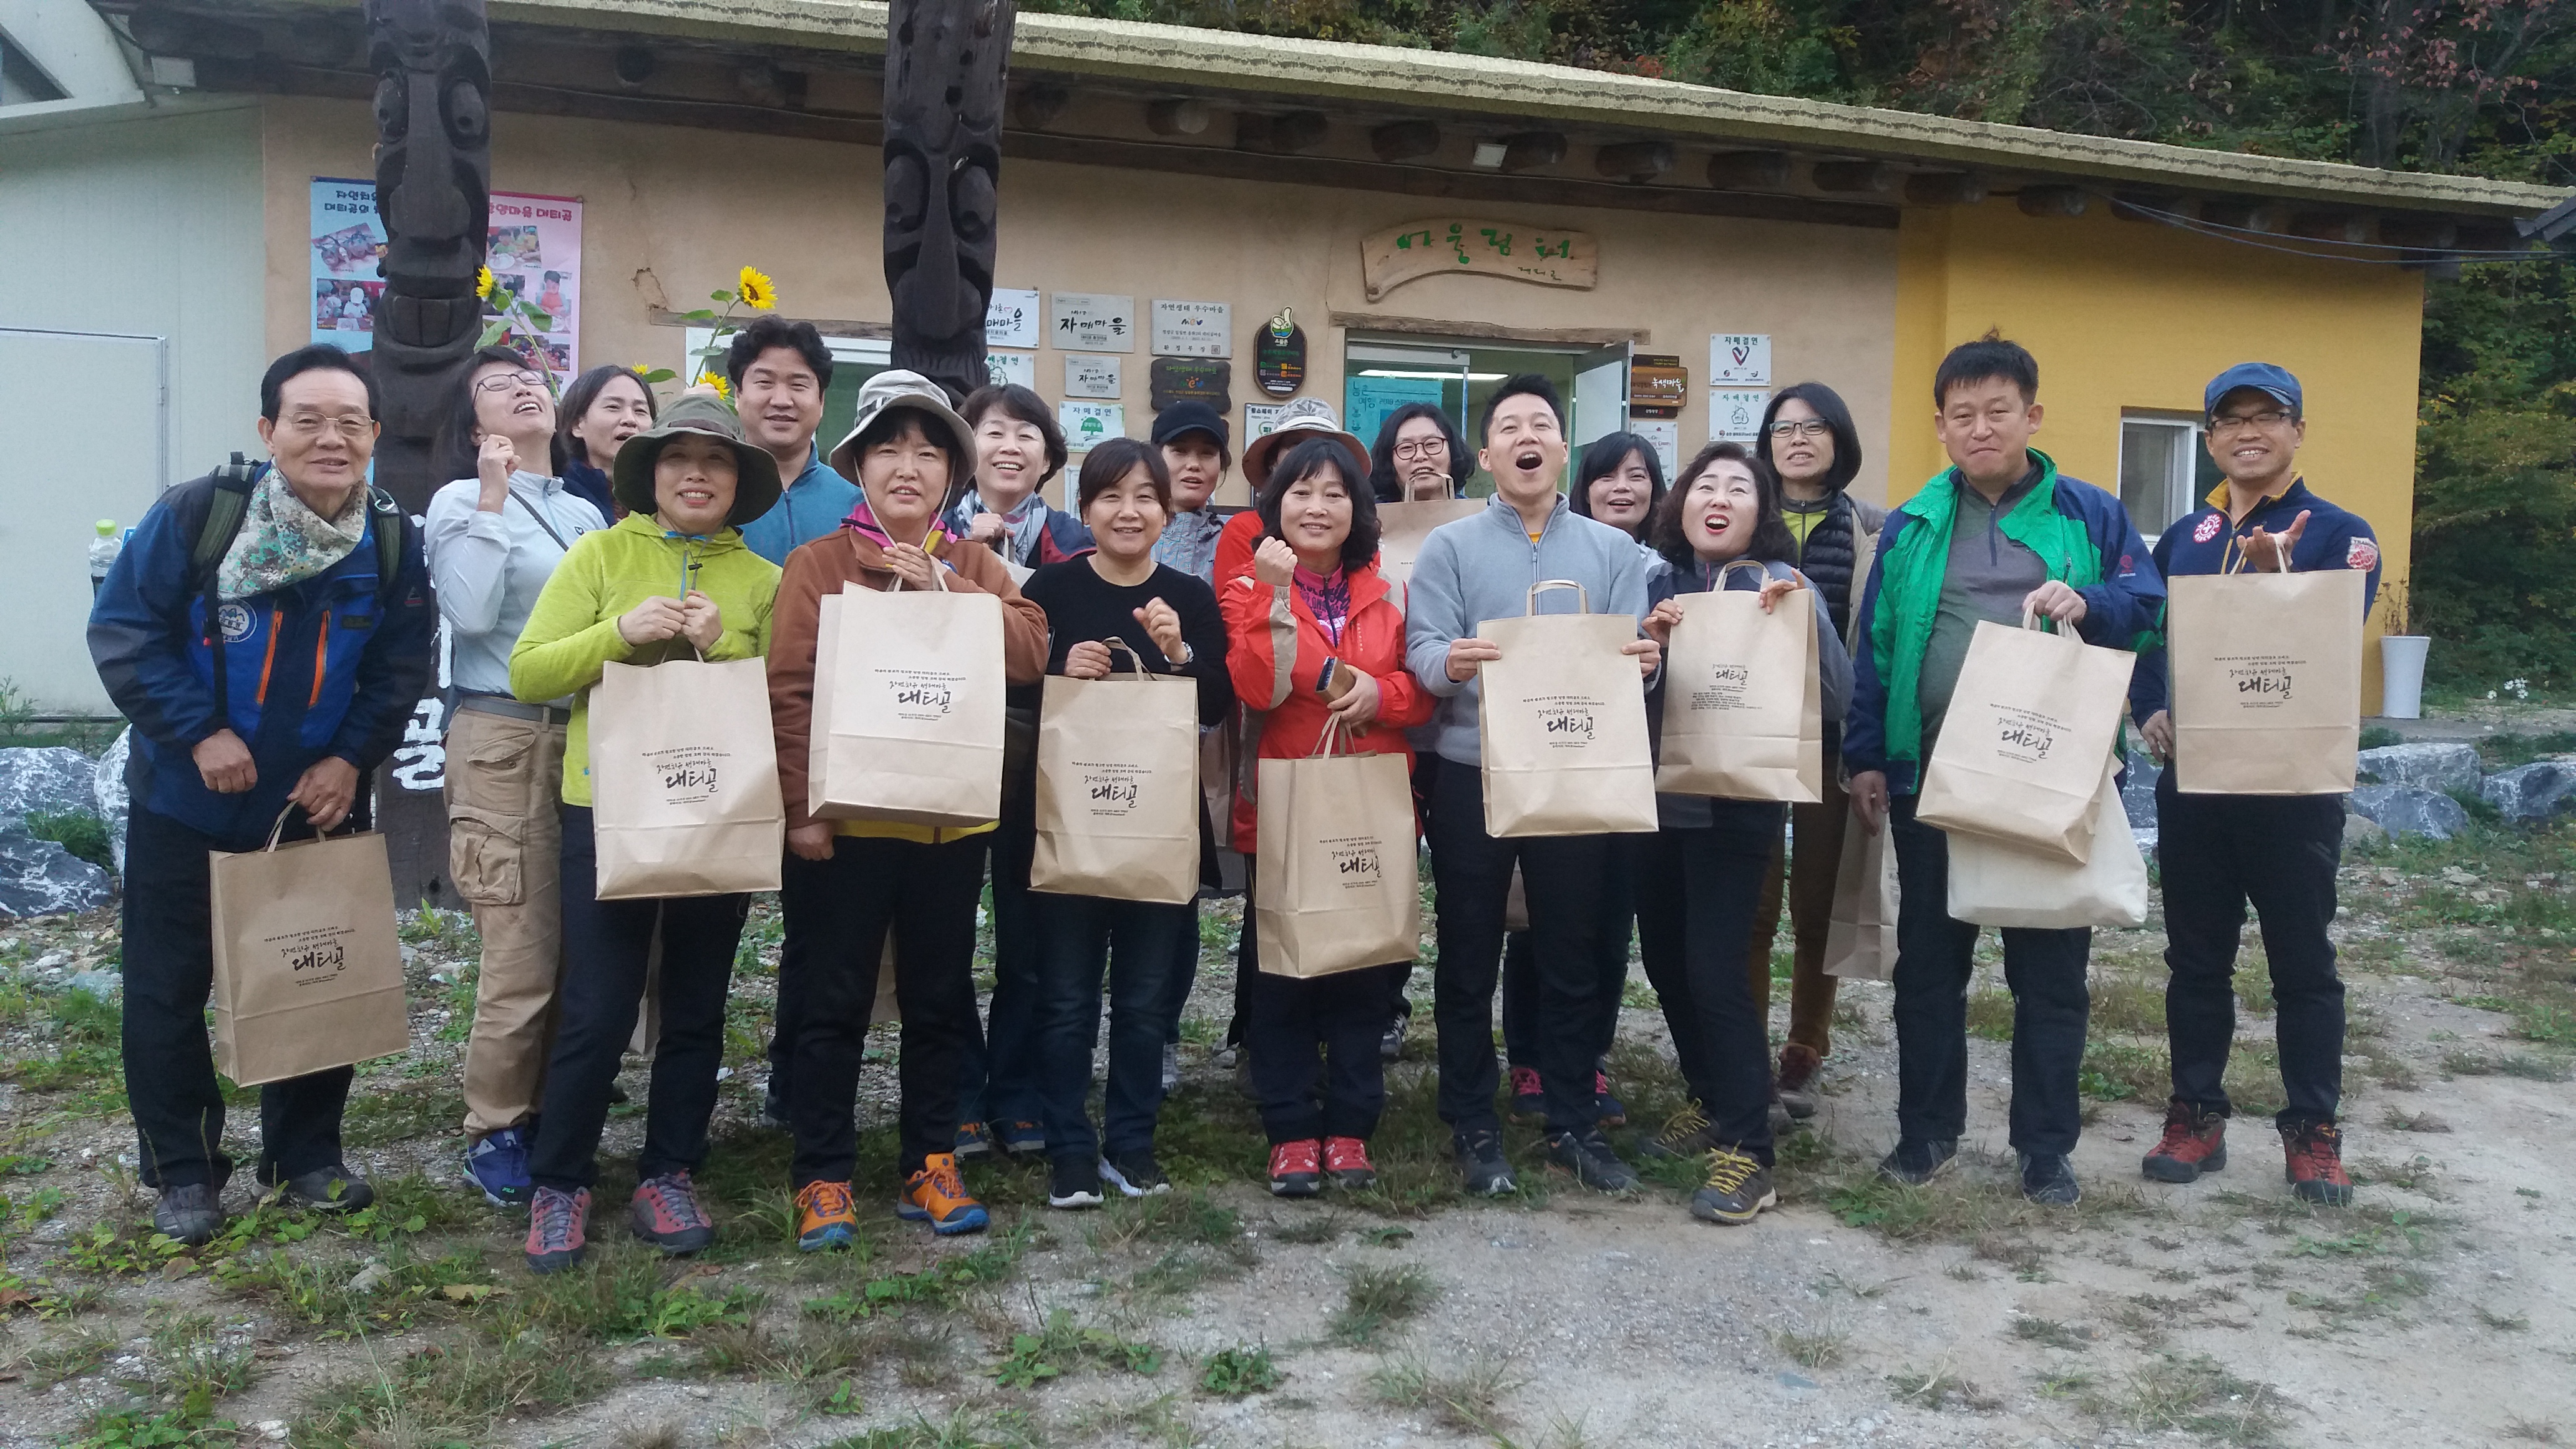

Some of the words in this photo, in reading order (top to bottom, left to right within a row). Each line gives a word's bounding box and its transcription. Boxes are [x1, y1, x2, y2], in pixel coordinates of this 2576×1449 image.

[986, 307, 1023, 332] 매마을
[1161, 303, 1191, 311] 자연생태
[1194, 305, 1224, 314] 우수마을
[1060, 316, 1127, 336] 자매마을
[1724, 336, 1758, 346] 자매결연
[988, 354, 1018, 366] 매결연
[1078, 374, 1116, 384] 자매마을
[1651, 376, 1685, 393] 녹색마을
[1073, 407, 1111, 417] 자매결연
[1715, 668, 1749, 686] 대티골
[2238, 676, 2293, 700] 대티골
[897, 689, 951, 714] 대티골
[1546, 716, 1596, 740] 대티골
[2002, 729, 2053, 759] 대티골
[665, 768, 719, 793] 대티골
[1091, 783, 1138, 809] 대티골
[1340, 855, 1382, 878] 대티골
[292, 946, 346, 971] 대티골
